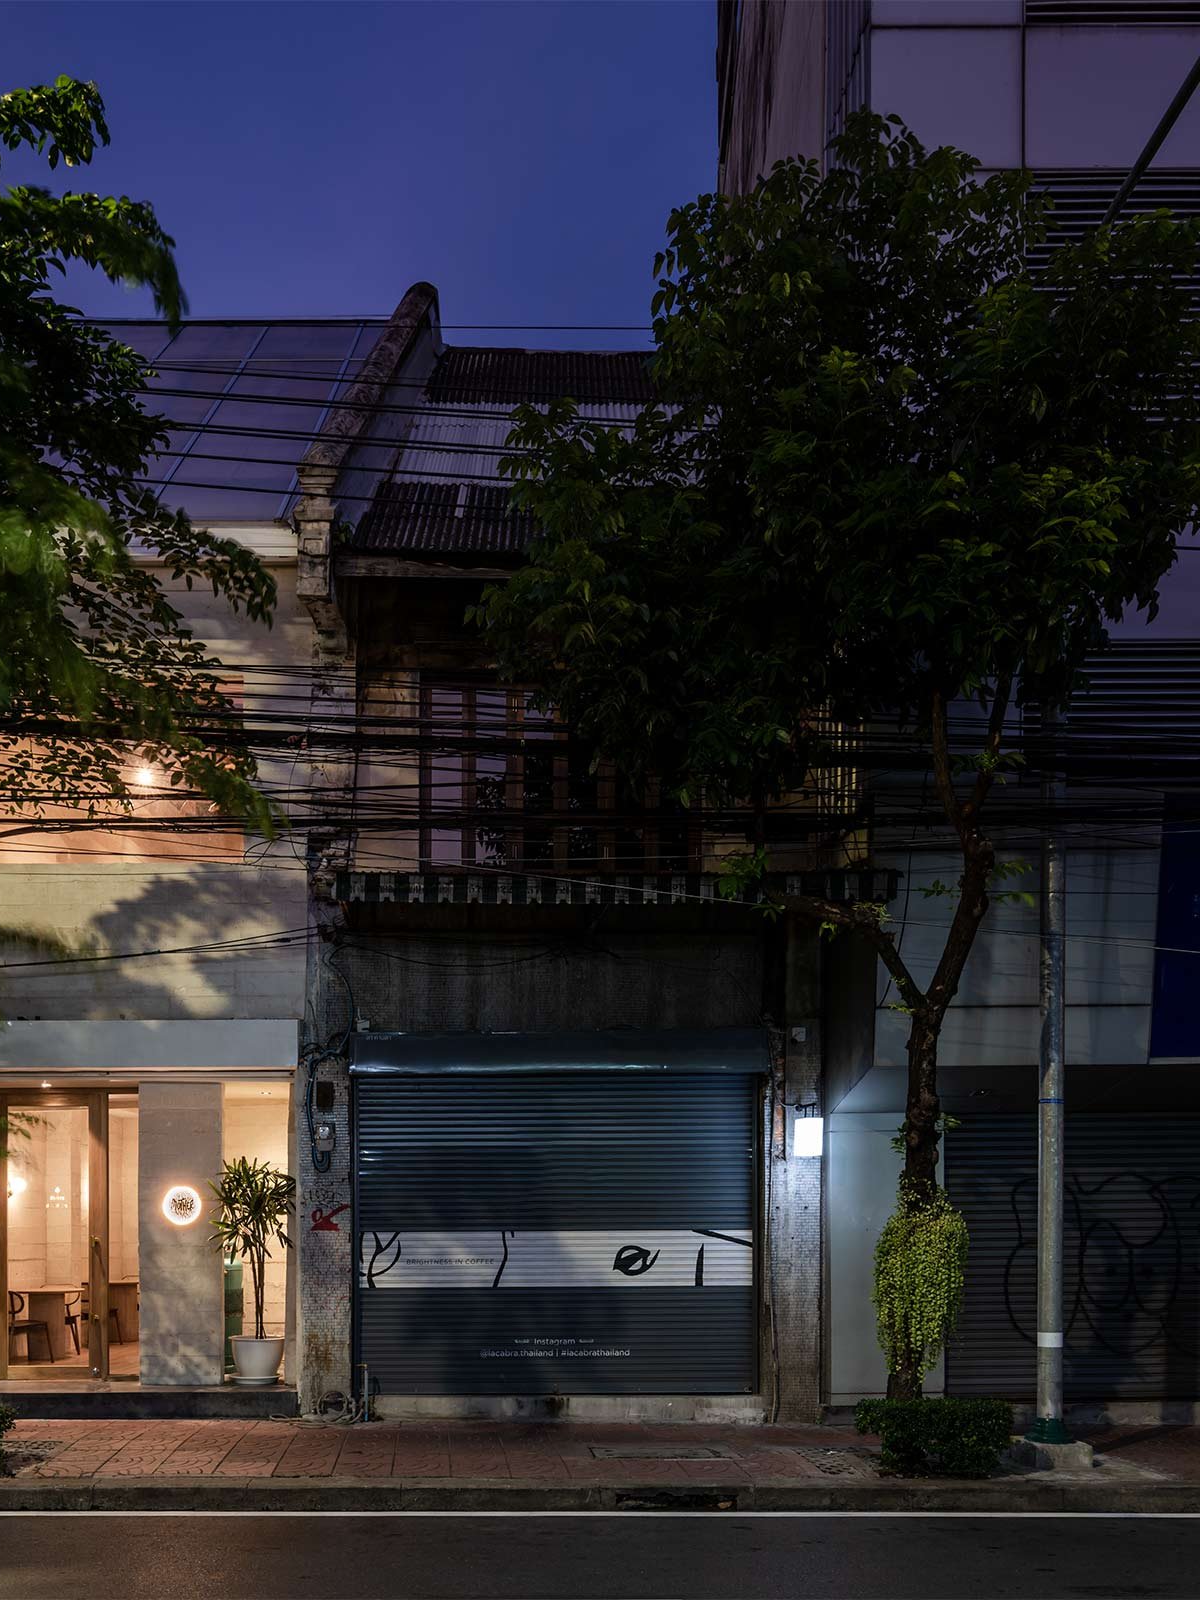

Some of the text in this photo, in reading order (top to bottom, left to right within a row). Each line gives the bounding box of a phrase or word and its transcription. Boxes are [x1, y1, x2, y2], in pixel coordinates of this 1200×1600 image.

[533, 1338, 576, 1346] Instagram
[480, 1348, 630, 1357] @lacabra.thailand #lacabrathailand
